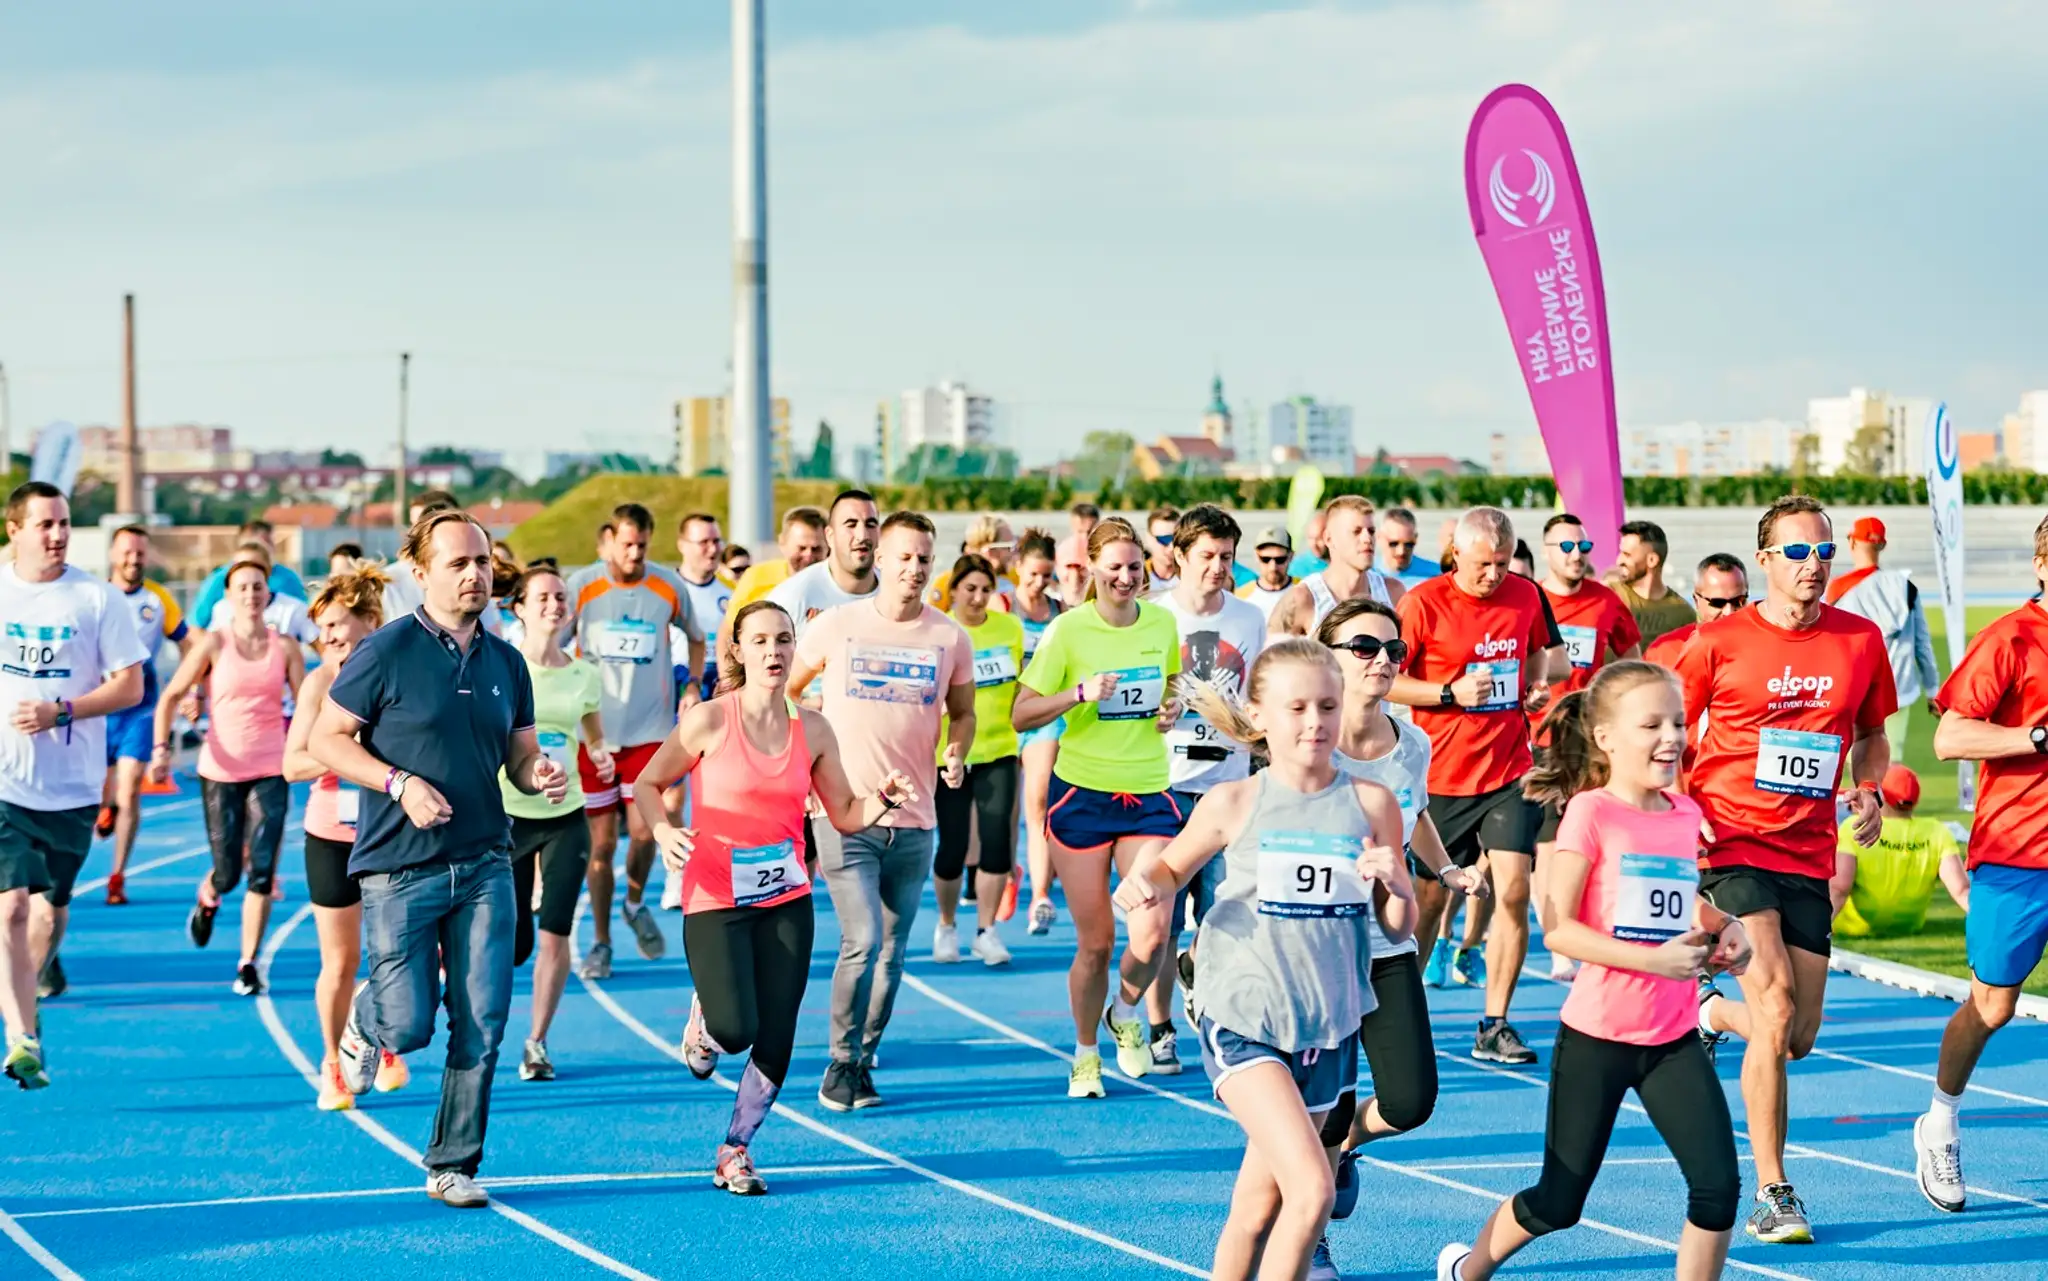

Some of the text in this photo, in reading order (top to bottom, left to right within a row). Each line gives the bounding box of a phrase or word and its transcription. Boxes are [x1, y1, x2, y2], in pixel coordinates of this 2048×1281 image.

[18, 645, 55, 665] 100
[619, 638, 639, 652] 27
[977, 662, 1001, 676] 191
[1766, 665, 1834, 699] elcop
[1120, 687, 1144, 706] 12
[1767, 702, 1777, 710] PR
[1783, 700, 1804, 709] EVENT
[1804, 699, 1831, 708] AGENCY
[1777, 754, 1821, 780] 105
[757, 866, 785, 888] 22
[1296, 863, 1333, 894] 91
[1650, 888, 1683, 919] 90
